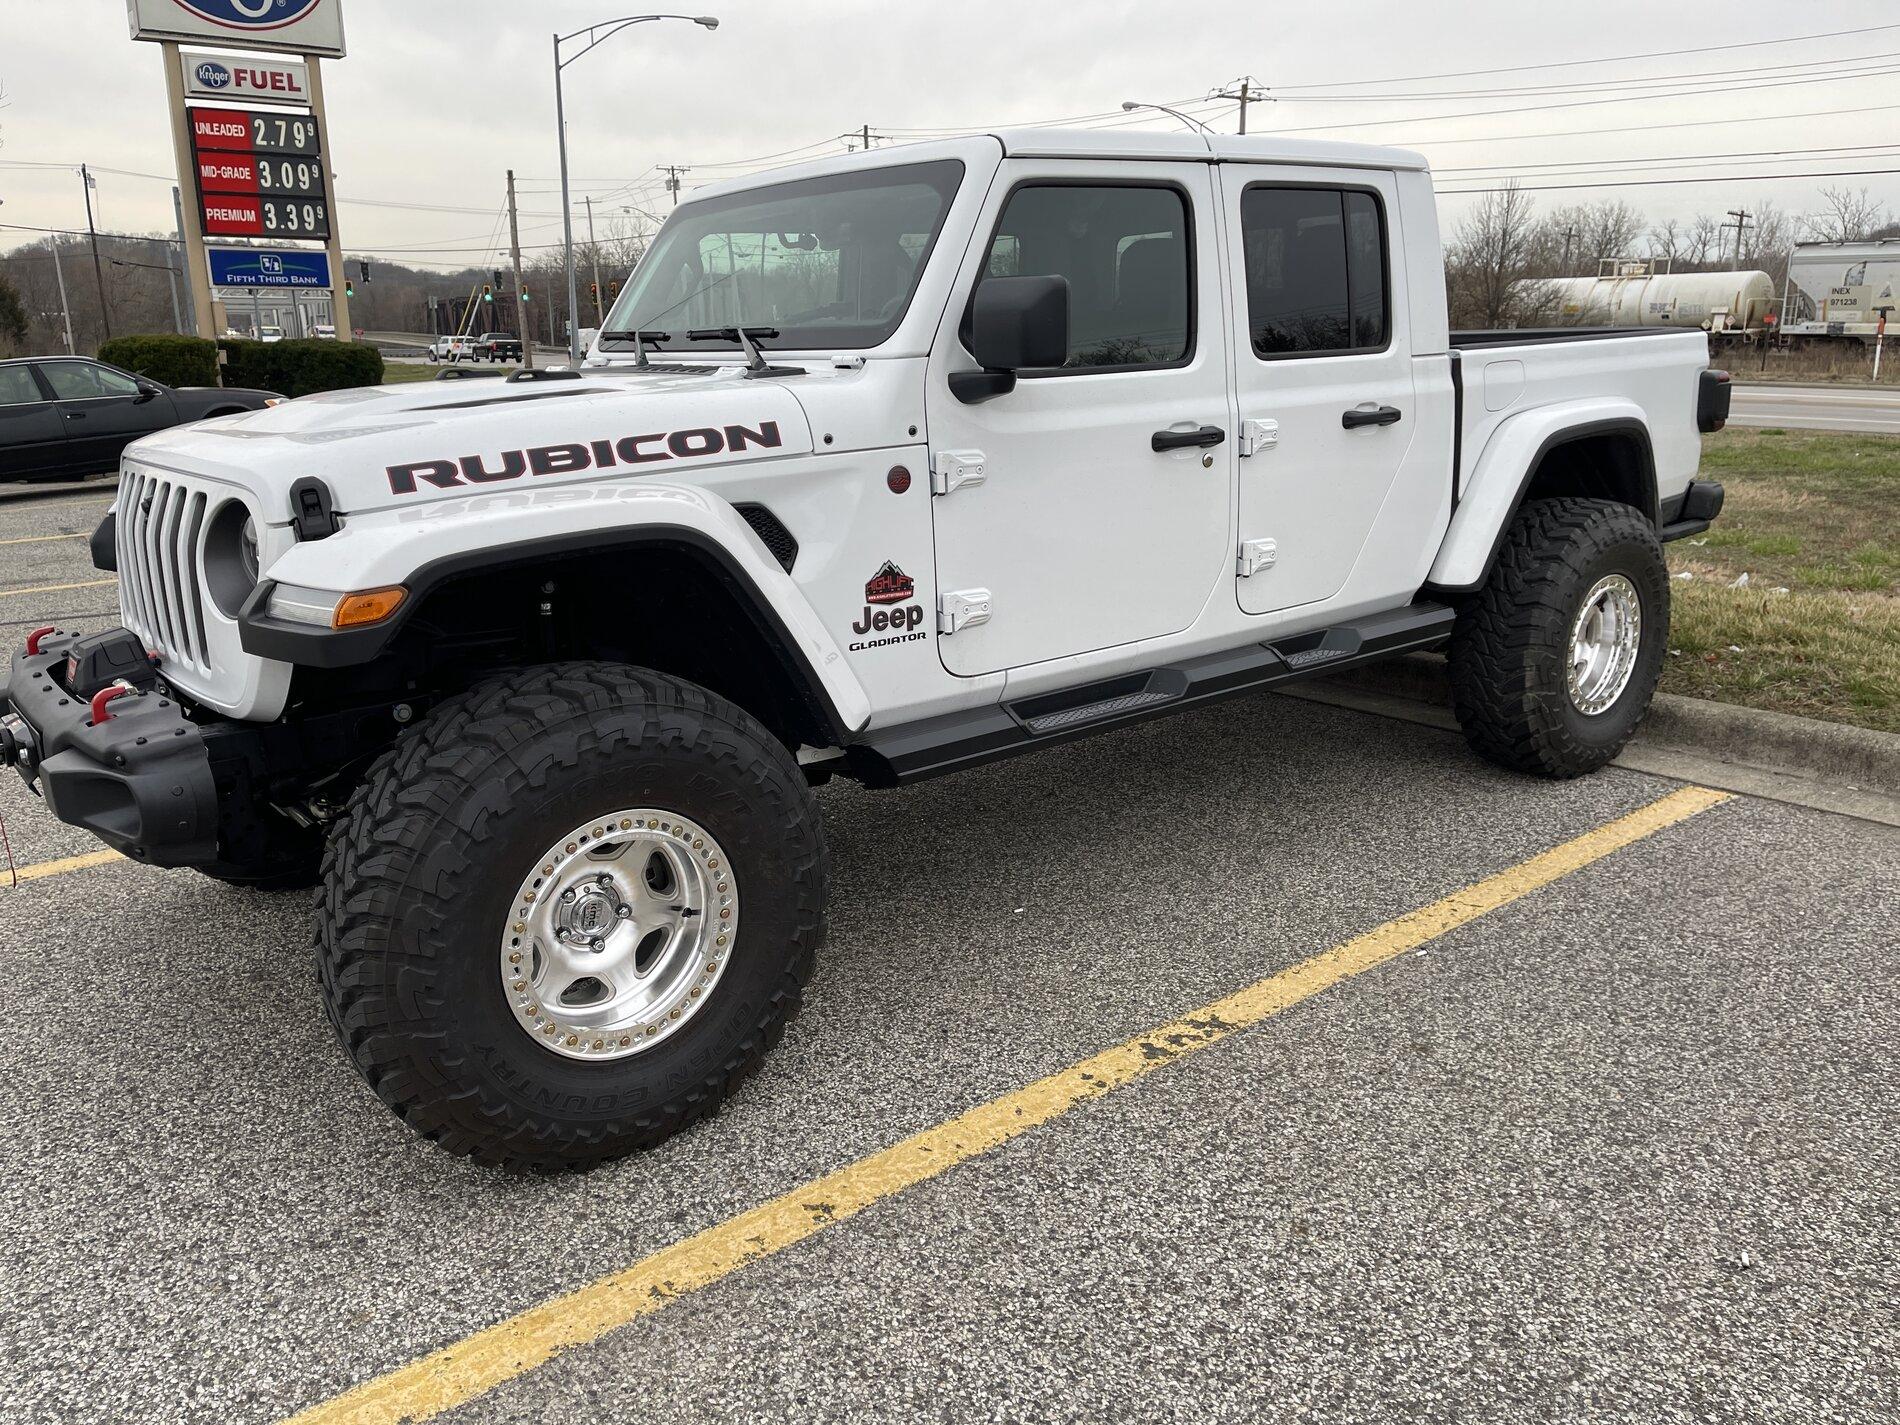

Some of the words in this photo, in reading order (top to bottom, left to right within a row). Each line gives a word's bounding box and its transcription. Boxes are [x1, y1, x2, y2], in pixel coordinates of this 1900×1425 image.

[199, 64, 229, 87] Kroger
[234, 68, 302, 92] FUEL
[195, 122, 245, 137] UNLEADED
[201, 165, 251, 179] MID-GRADE
[206, 208, 256, 221] PREMIUM
[227, 274, 255, 283] FIFTH
[258, 275, 289, 284] THIRD
[290, 275, 318, 284] BANK
[1831, 287, 1851, 295] INEX
[1830, 298, 1857, 306] 971238
[386, 421, 782, 494] RUBICON
[853, 605, 923, 634] Jeep
[849, 632, 926, 651] GLADIATOR
